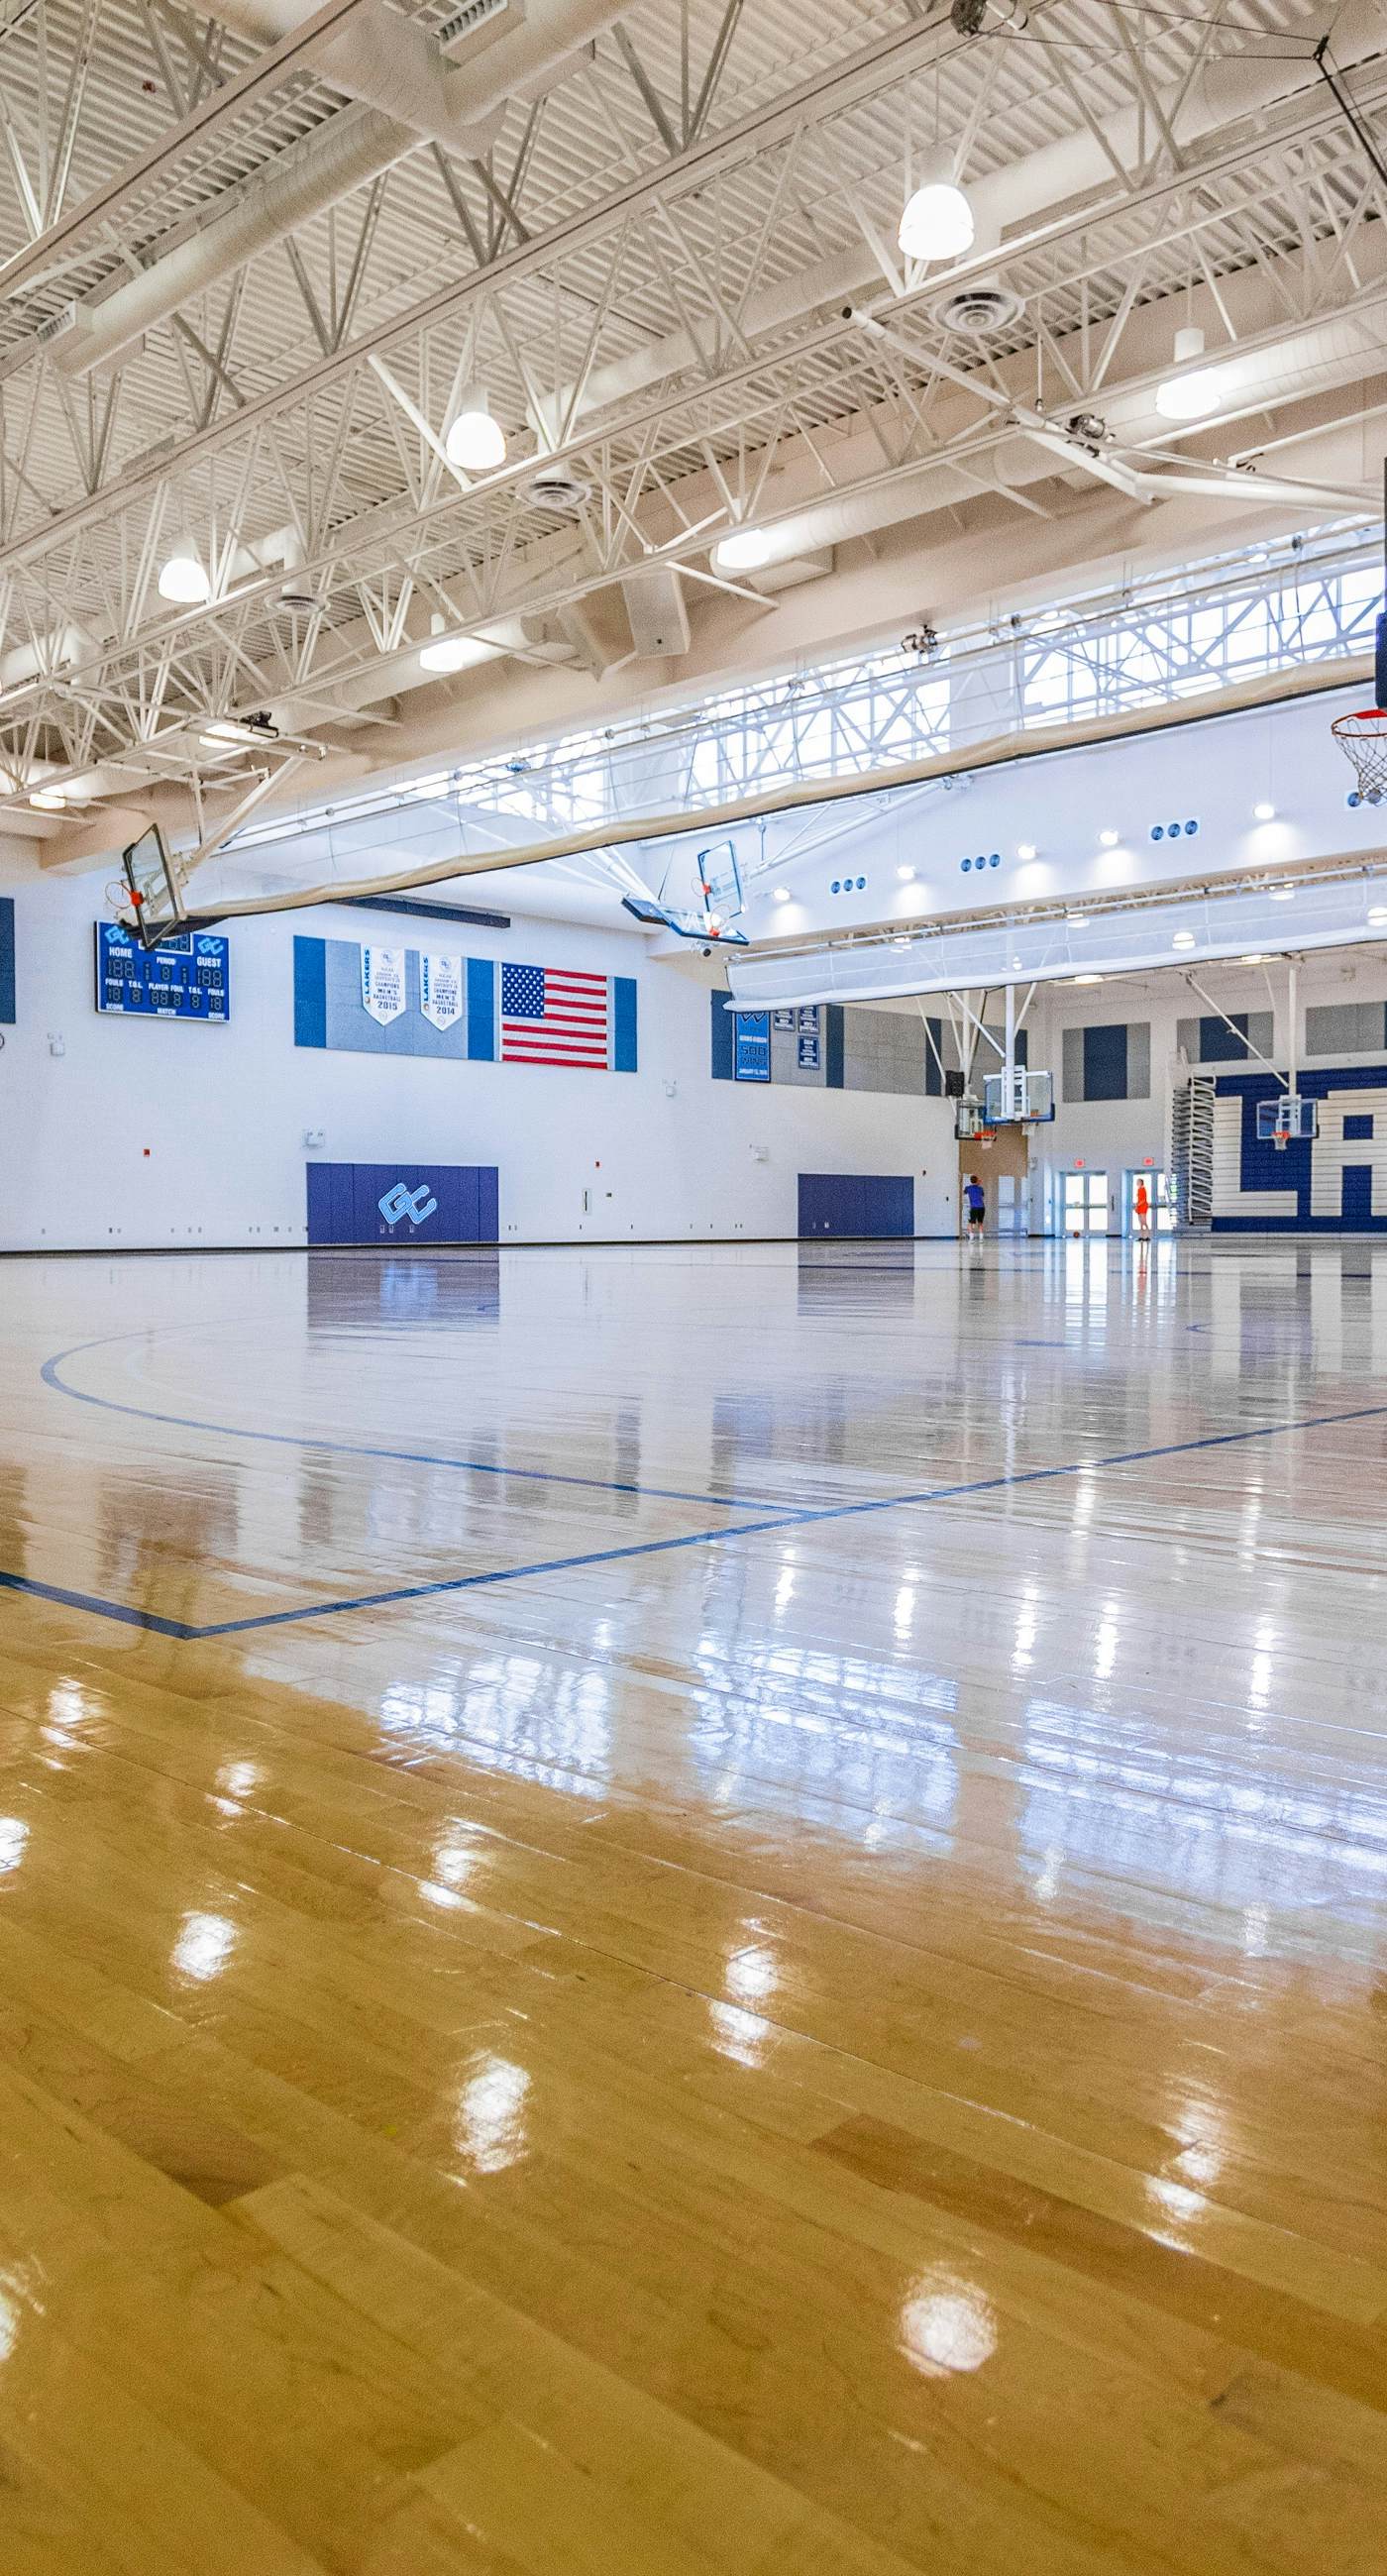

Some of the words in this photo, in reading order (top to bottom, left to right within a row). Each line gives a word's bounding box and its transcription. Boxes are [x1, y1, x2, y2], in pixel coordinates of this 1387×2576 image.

[109, 946, 133, 958] HOME
[157, 956, 176, 965] PERIOD
[196, 956, 222, 968] GUEST
[105, 977, 124, 987] FOULS
[149, 982, 169, 991] PLAYER
[169, 984, 184, 993] FOUL
[207, 988, 225, 997] FOULS
[376, 1001, 398, 1011] 2015
[436, 1006, 456, 1016] 2014
